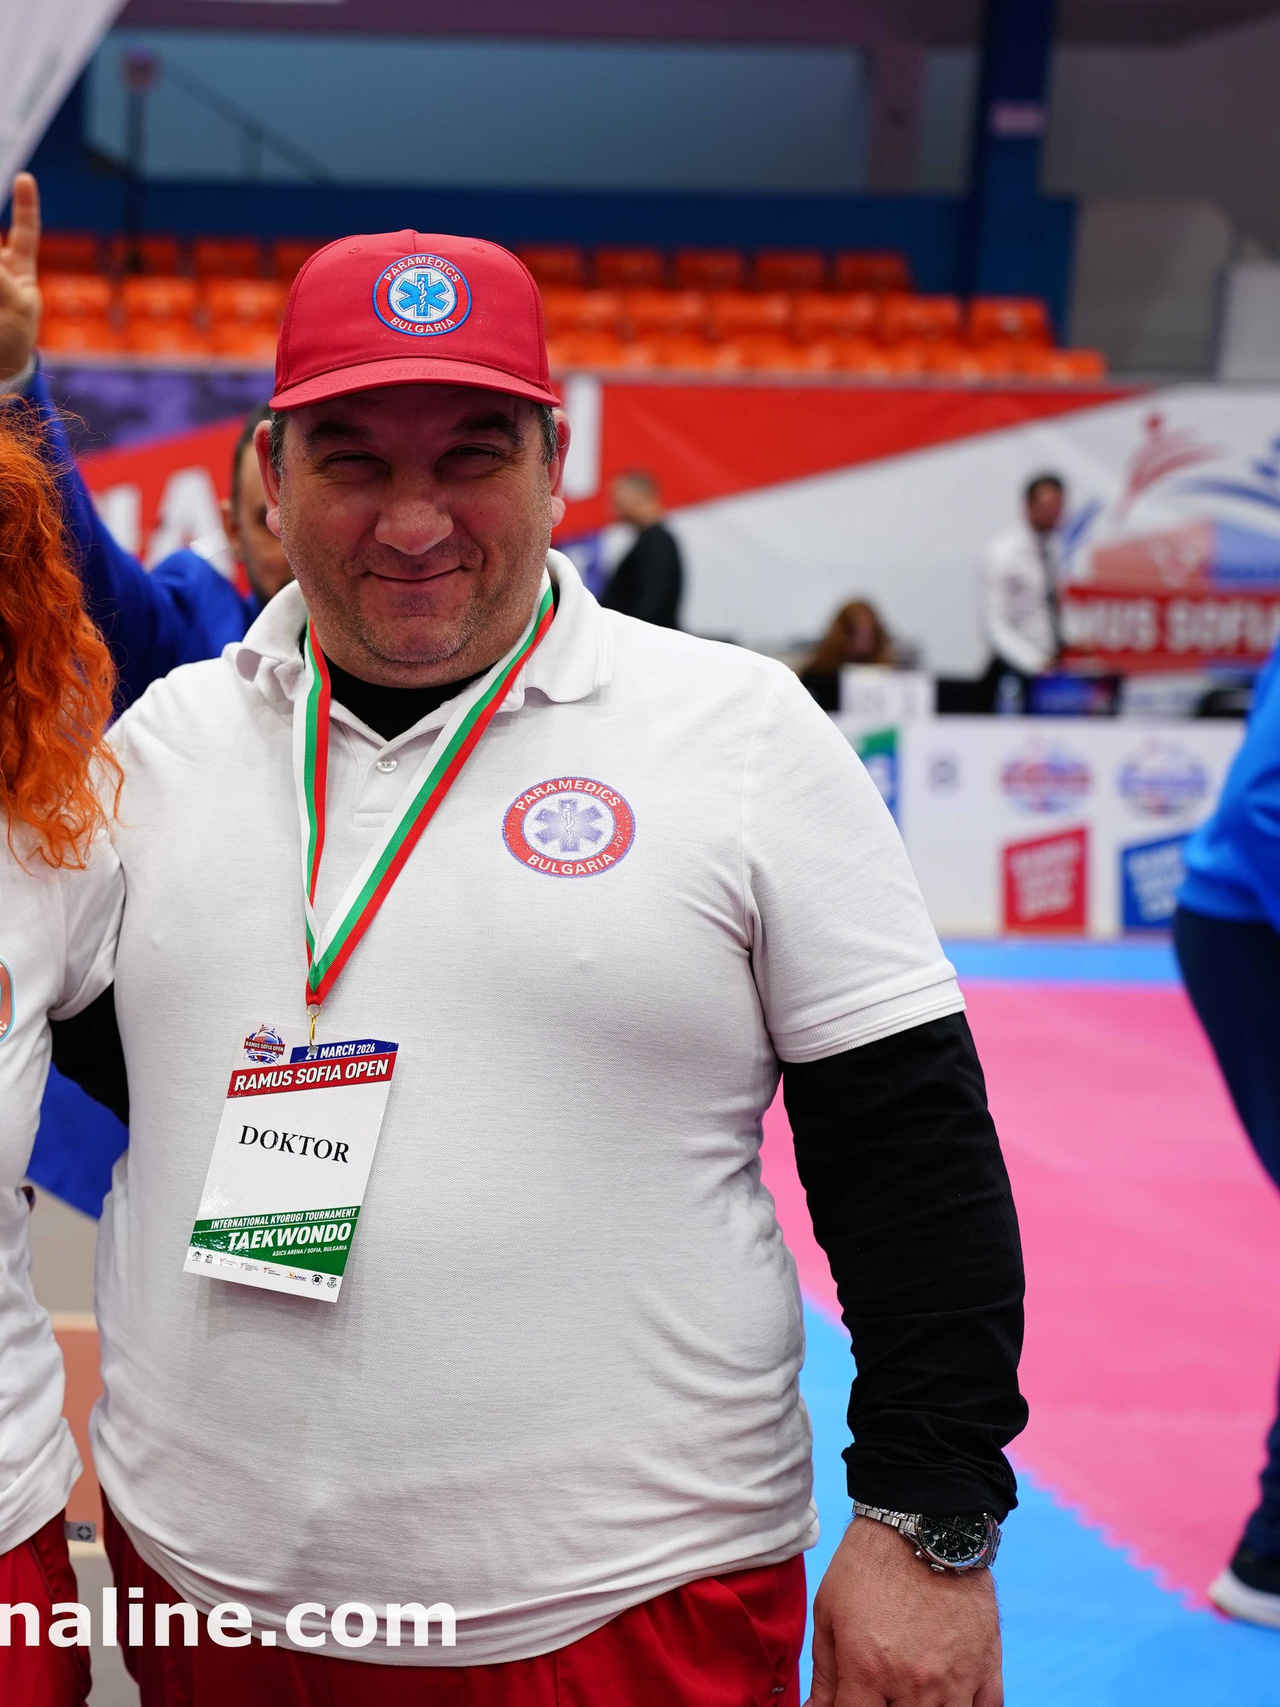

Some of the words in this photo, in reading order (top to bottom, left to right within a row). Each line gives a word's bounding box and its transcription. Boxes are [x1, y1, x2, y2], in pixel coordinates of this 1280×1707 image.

[383, 256, 461, 282] PARAMEDICS
[389, 317, 455, 333] BULGARIA
[514, 779, 621, 811] PARAMEDICS
[526, 853, 616, 875] BULGARIA
[320, 1044, 355, 1059] MARCH
[356, 1043, 375, 1054] 2026
[234, 1069, 294, 1091] RAMUS
[296, 1064, 341, 1085] SOFIA
[344, 1058, 389, 1080] OPEN
[238, 1124, 350, 1163] DOKTOR
[210, 1217, 269, 1230] INTERNATIONAL
[270, 1213, 304, 1224] KYORUGI
[305, 1207, 357, 1220] TOURNAMENT
[227, 1222, 351, 1251] TAEKWONDO
[272, 1249, 287, 1257] ASICS
[287, 1247, 304, 1255] ARENA
[323, 1244, 347, 1253] BULGARIA
